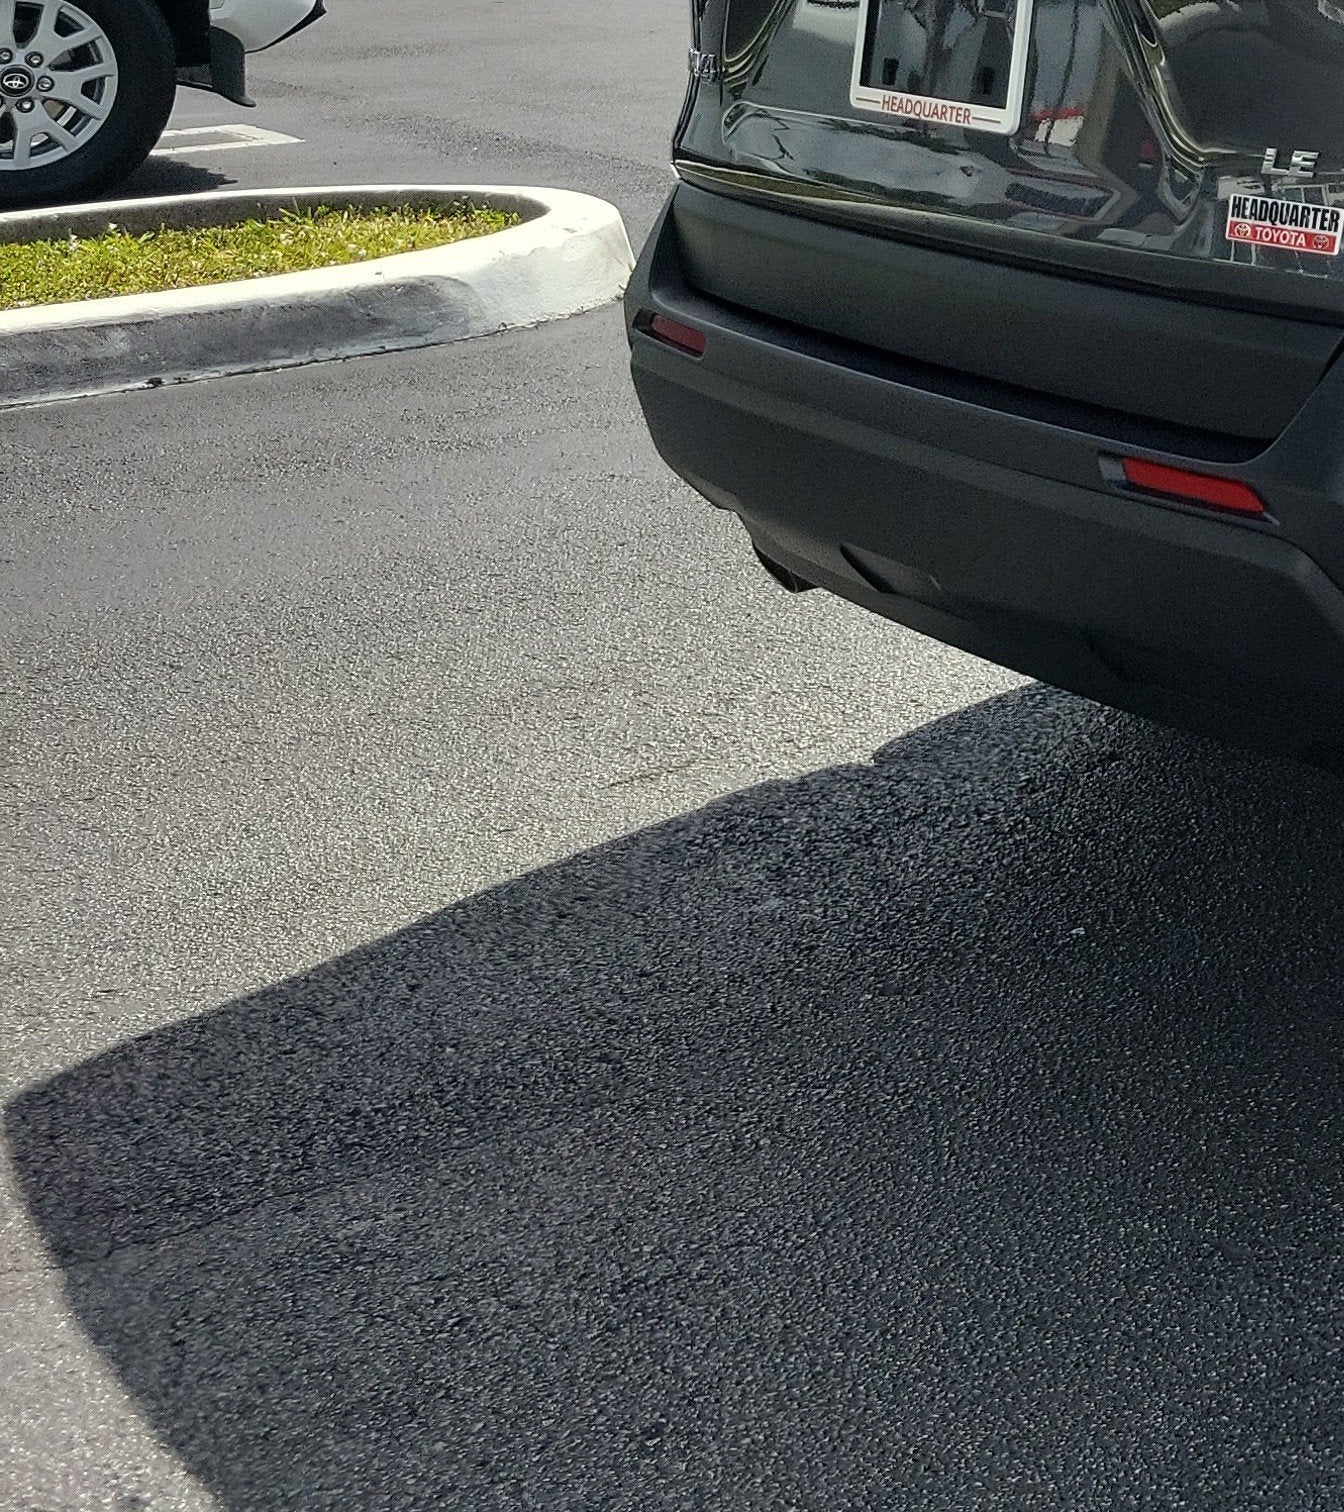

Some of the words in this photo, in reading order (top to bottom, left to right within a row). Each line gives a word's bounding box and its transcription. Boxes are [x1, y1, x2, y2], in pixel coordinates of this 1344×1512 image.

[881, 95, 971, 125] HEADQUARTER
[1261, 147, 1320, 178] LE
[1231, 195, 1341, 233] HEADQUARTER
[1255, 226, 1307, 247] TOYOTA
